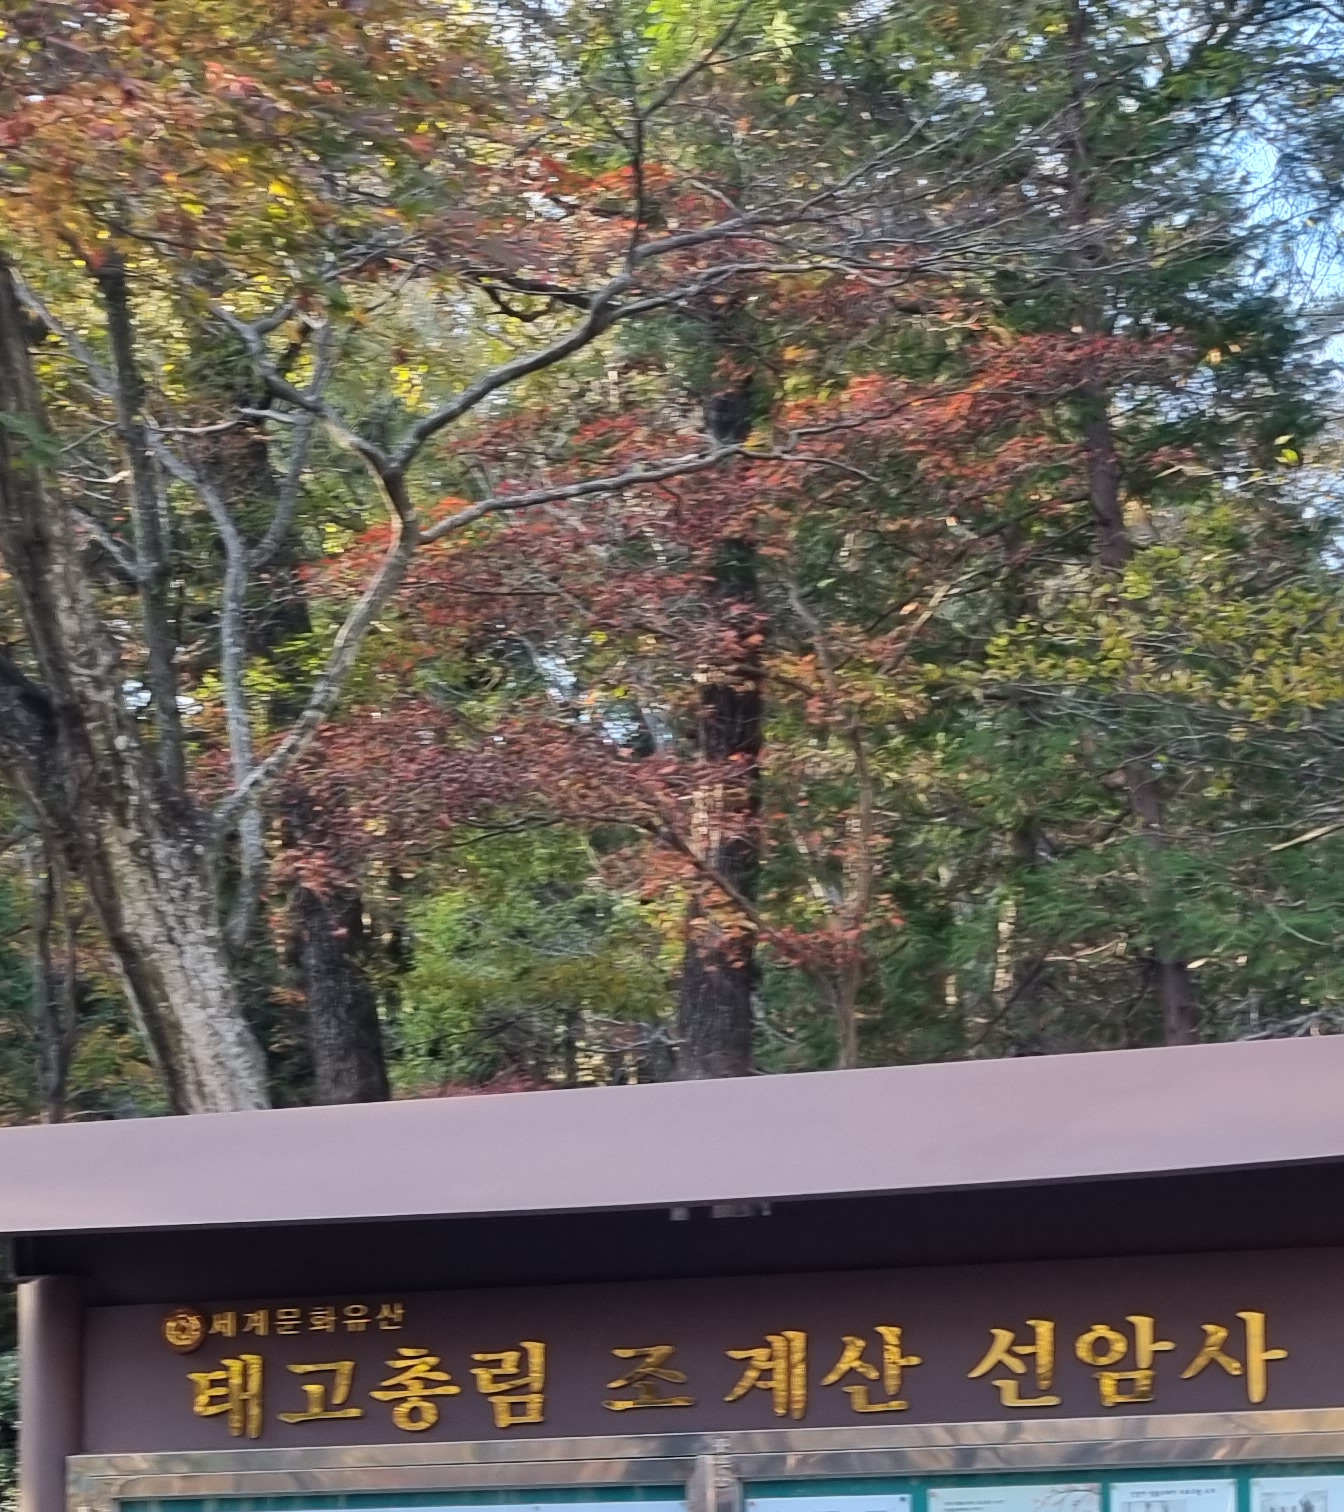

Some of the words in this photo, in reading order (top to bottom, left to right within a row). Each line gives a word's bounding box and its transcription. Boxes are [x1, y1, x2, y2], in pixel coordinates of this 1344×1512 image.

[208, 1303, 405, 1338] 세계문화유산
[186, 1341, 547, 1439] 태고총림
[967, 1311, 1289, 1409] 선암사
